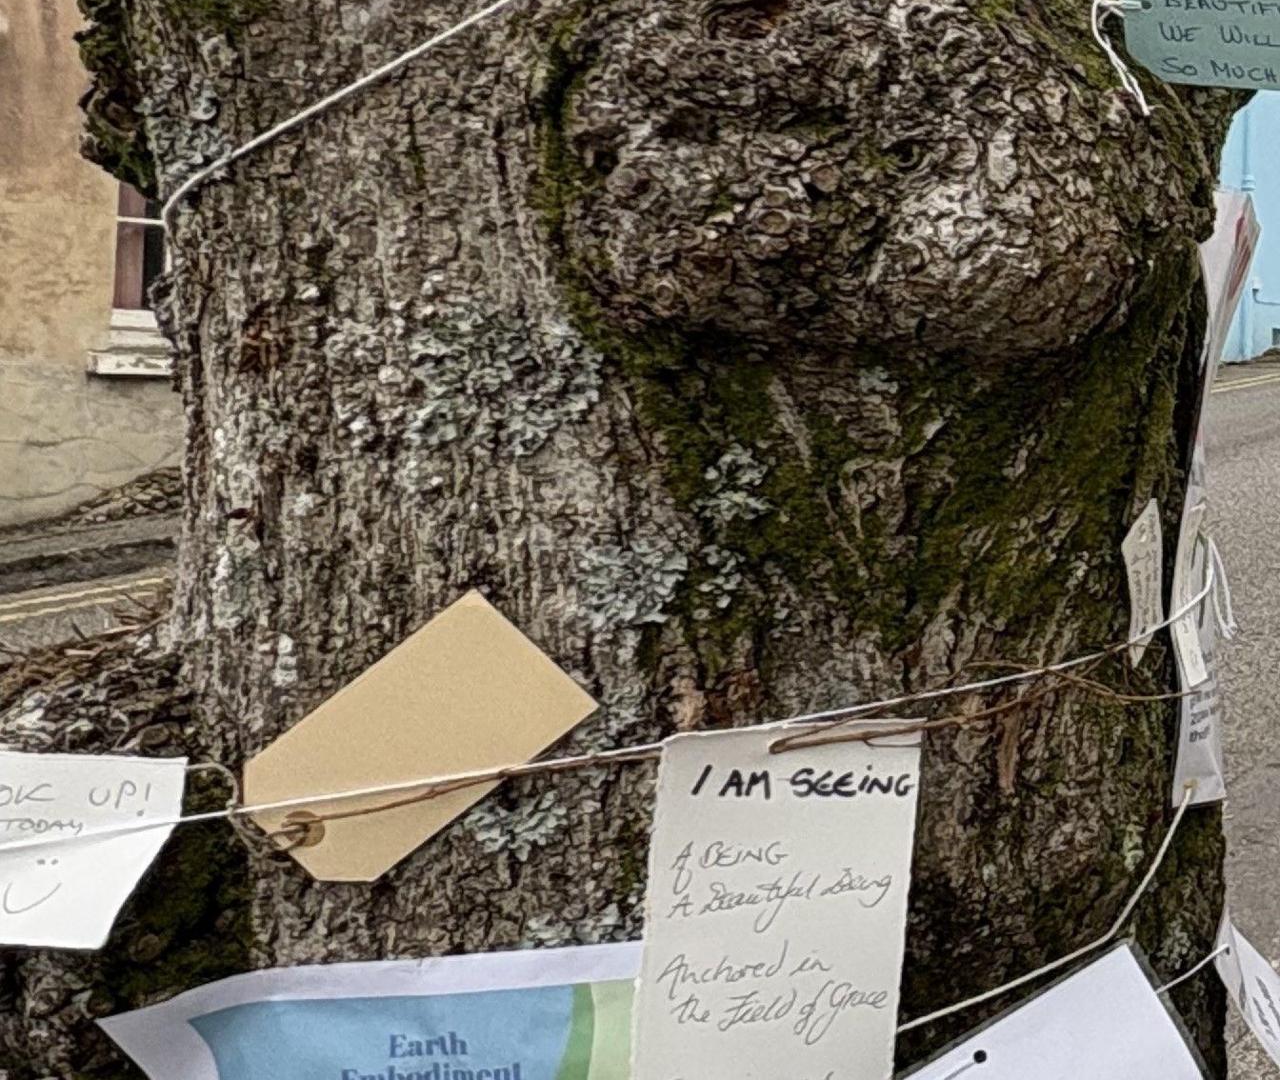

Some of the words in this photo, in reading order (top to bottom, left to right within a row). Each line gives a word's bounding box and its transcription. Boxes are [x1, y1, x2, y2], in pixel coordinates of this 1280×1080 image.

[1158, 21, 1202, 42] WE
[1160, 56, 1198, 76] SO
[691, 764, 713, 797] I
[718, 768, 772, 800] AM
[88, 780, 152, 817] UP!
[667, 894, 694, 919] A
[388, 1031, 468, 1058] Earth
